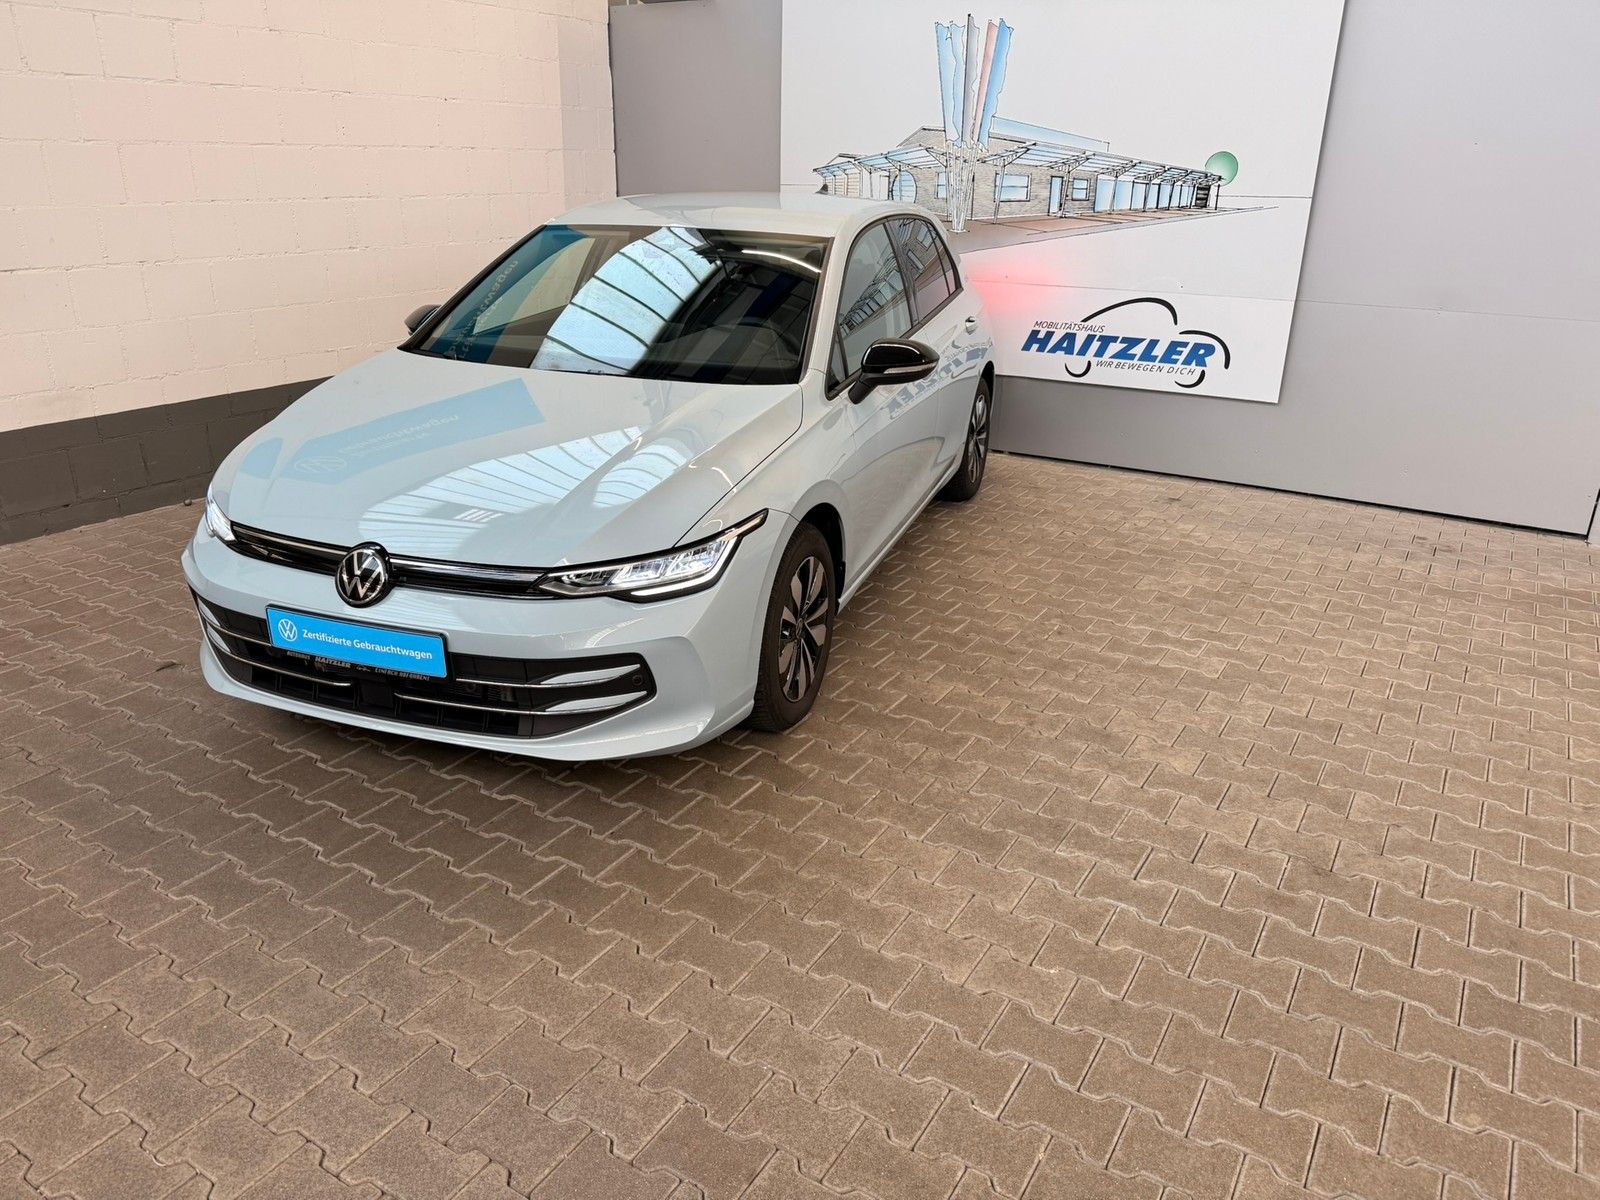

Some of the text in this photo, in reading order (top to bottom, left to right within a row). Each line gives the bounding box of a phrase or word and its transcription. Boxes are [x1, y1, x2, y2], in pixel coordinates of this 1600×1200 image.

[1033, 320, 1105, 334] MOBILITÄTSHAUS
[1021, 329, 1216, 367] HAITZLER
[1096, 360, 1196, 376] WIR BEWEGEN DICH
[302, 628, 352, 647] Zertifizierte
[353, 639, 433, 660] Gebrauchtwagen
